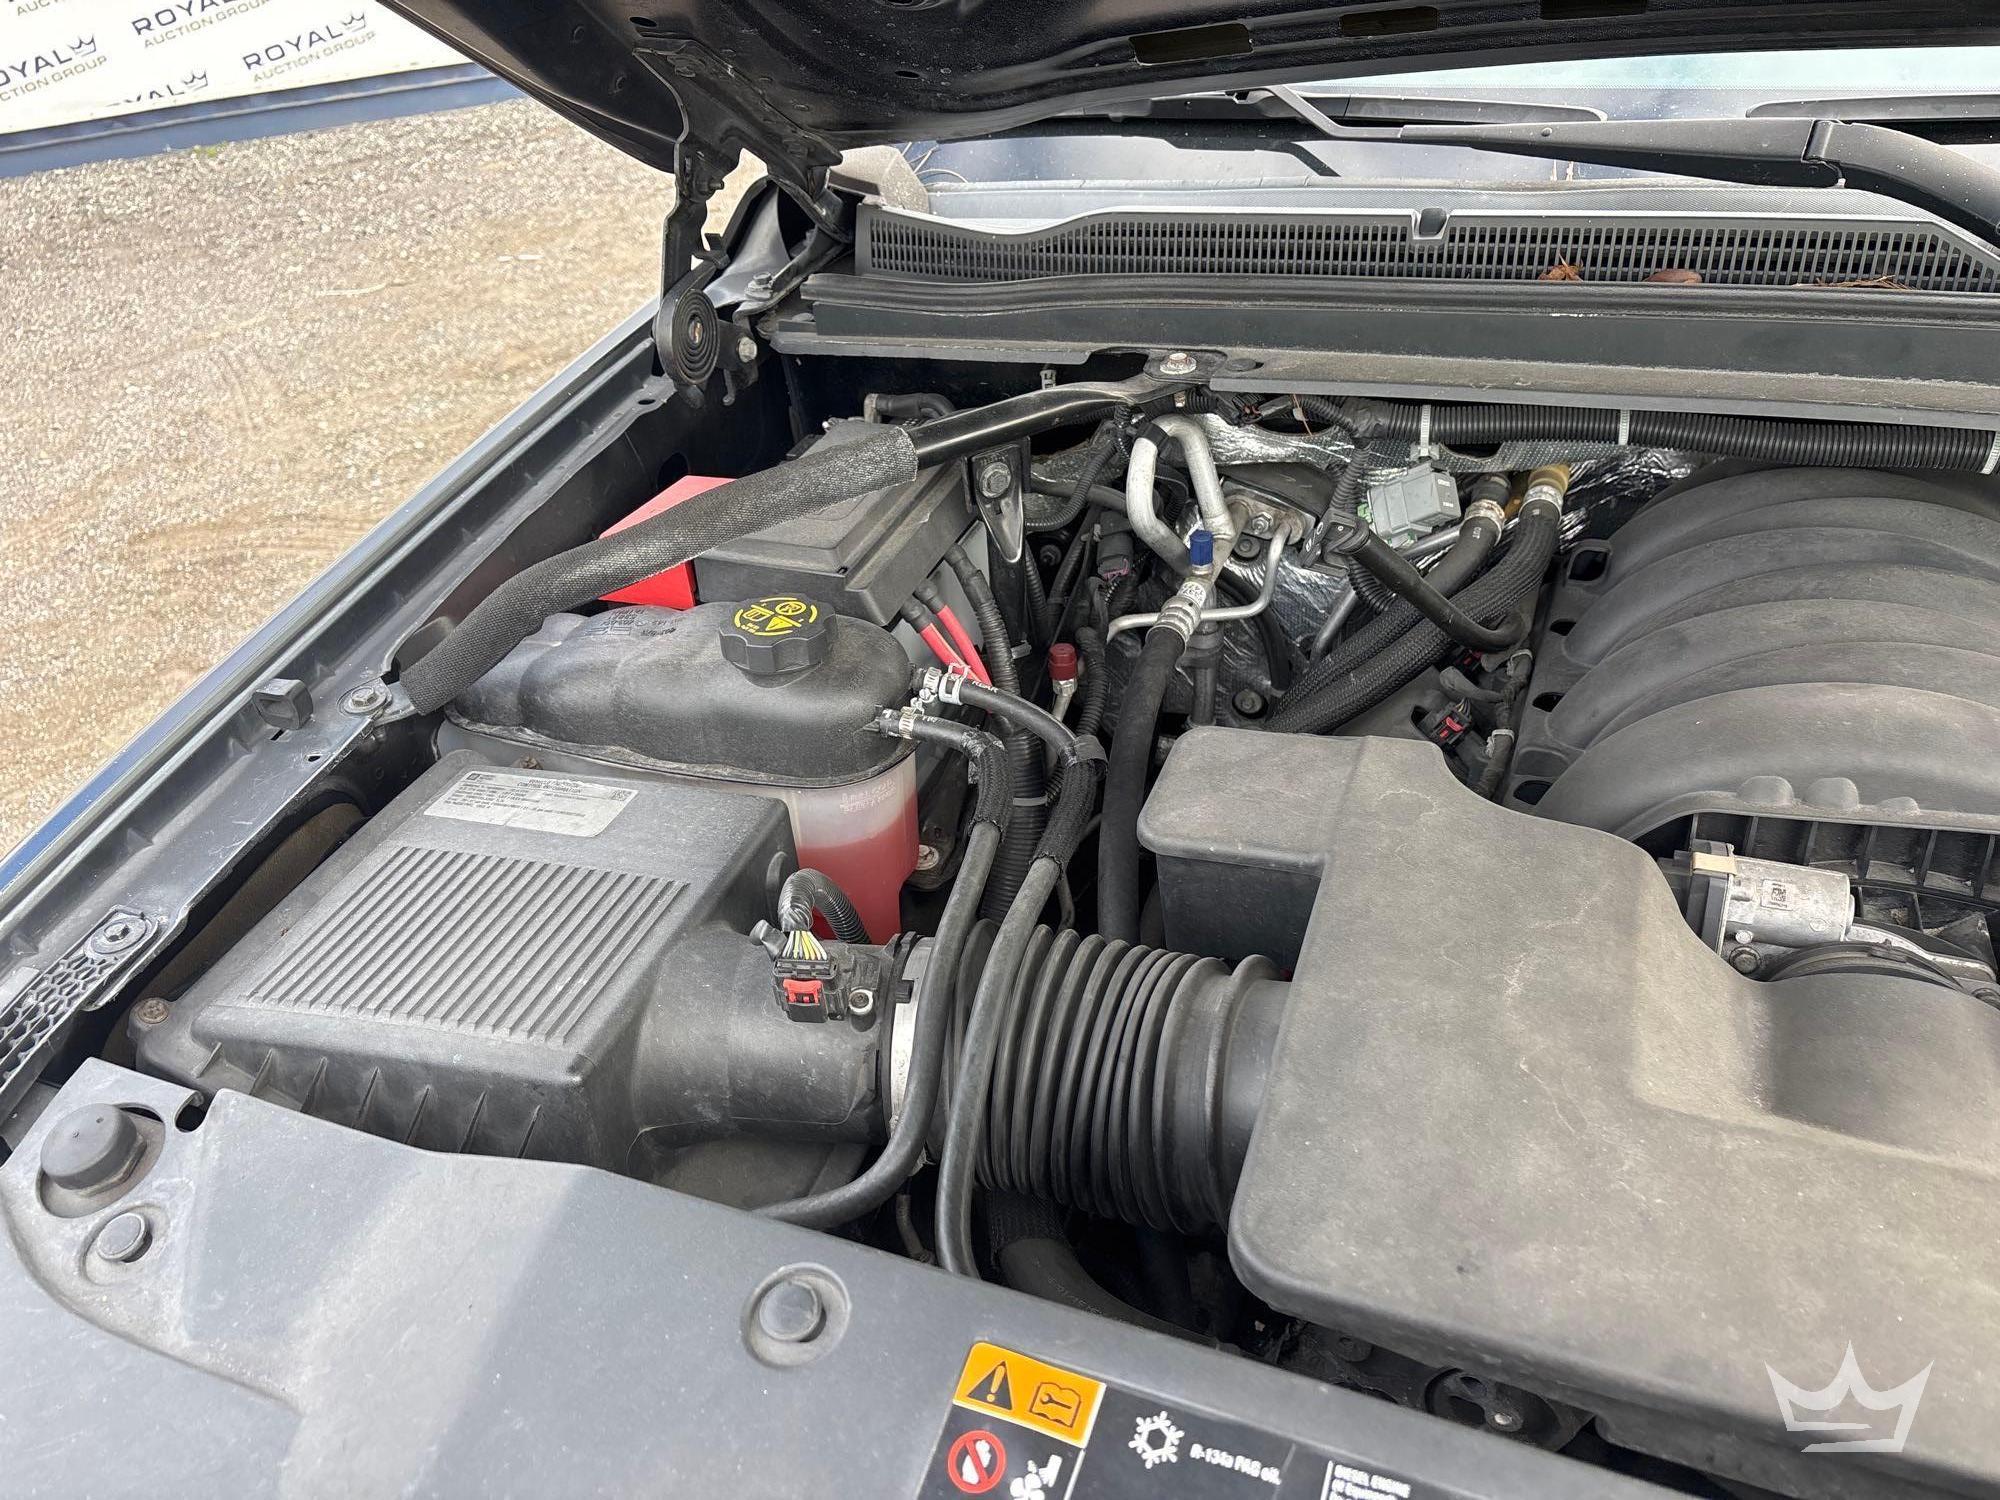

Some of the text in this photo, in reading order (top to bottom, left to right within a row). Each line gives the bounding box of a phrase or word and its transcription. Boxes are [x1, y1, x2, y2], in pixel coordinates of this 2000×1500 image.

[131, 0, 236, 36] ROYA
[144, 16, 213, 48] AUCTION
[242, 25, 343, 70] ROYAL
[253, 31, 375, 82] AUCTION GROUP
[51, 55, 107, 82] GROUP
